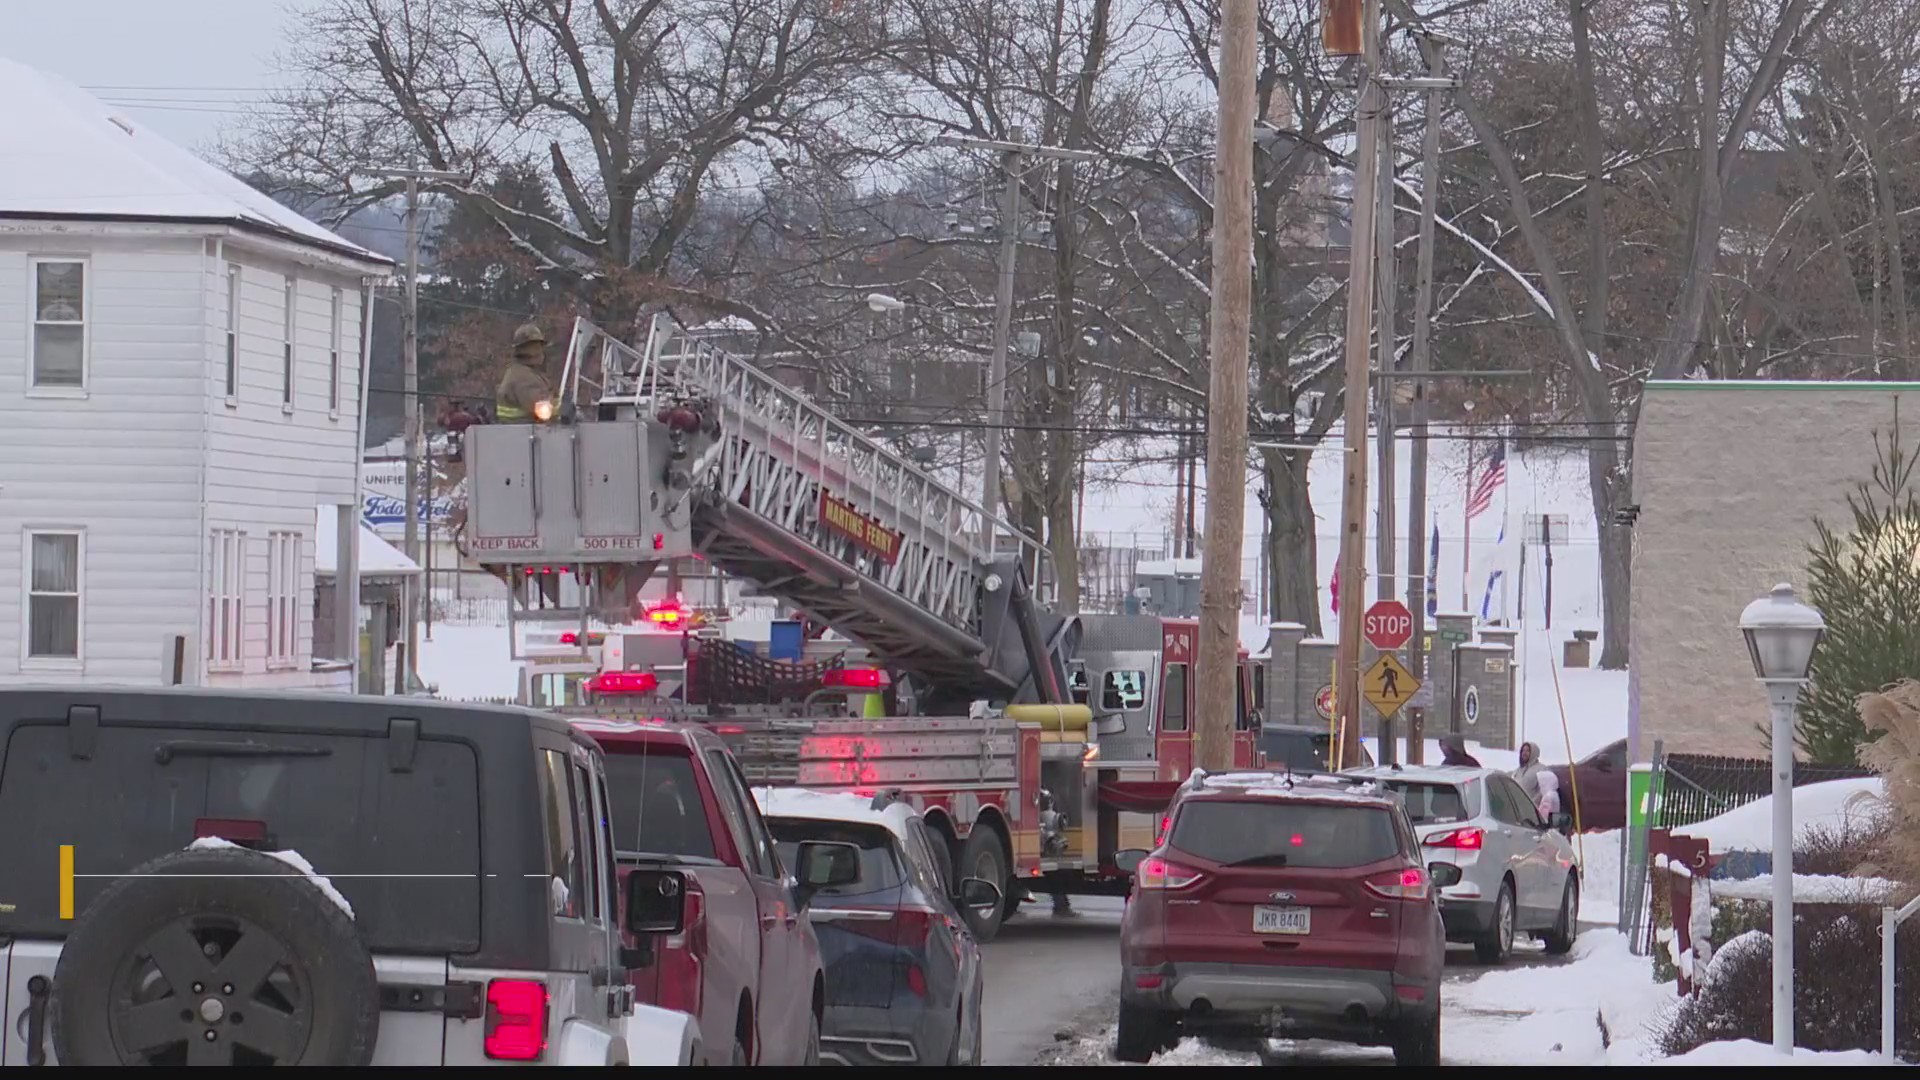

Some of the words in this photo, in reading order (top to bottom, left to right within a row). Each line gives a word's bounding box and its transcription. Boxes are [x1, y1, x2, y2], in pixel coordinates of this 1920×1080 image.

[366, 475, 406, 485] UNIFIE
[363, 496, 406, 517] Fodo
[825, 499, 864, 539] MARTINS
[866, 523, 893, 554] FERRY
[471, 538, 503, 549] KEEP
[507, 538, 540, 549] BACK
[584, 538, 608, 549] 500
[612, 538, 641, 549] FEET
[1366, 616, 1411, 634] STOP
[1692, 849, 1706, 868] 5
[1258, 911, 1278, 927] JKR
